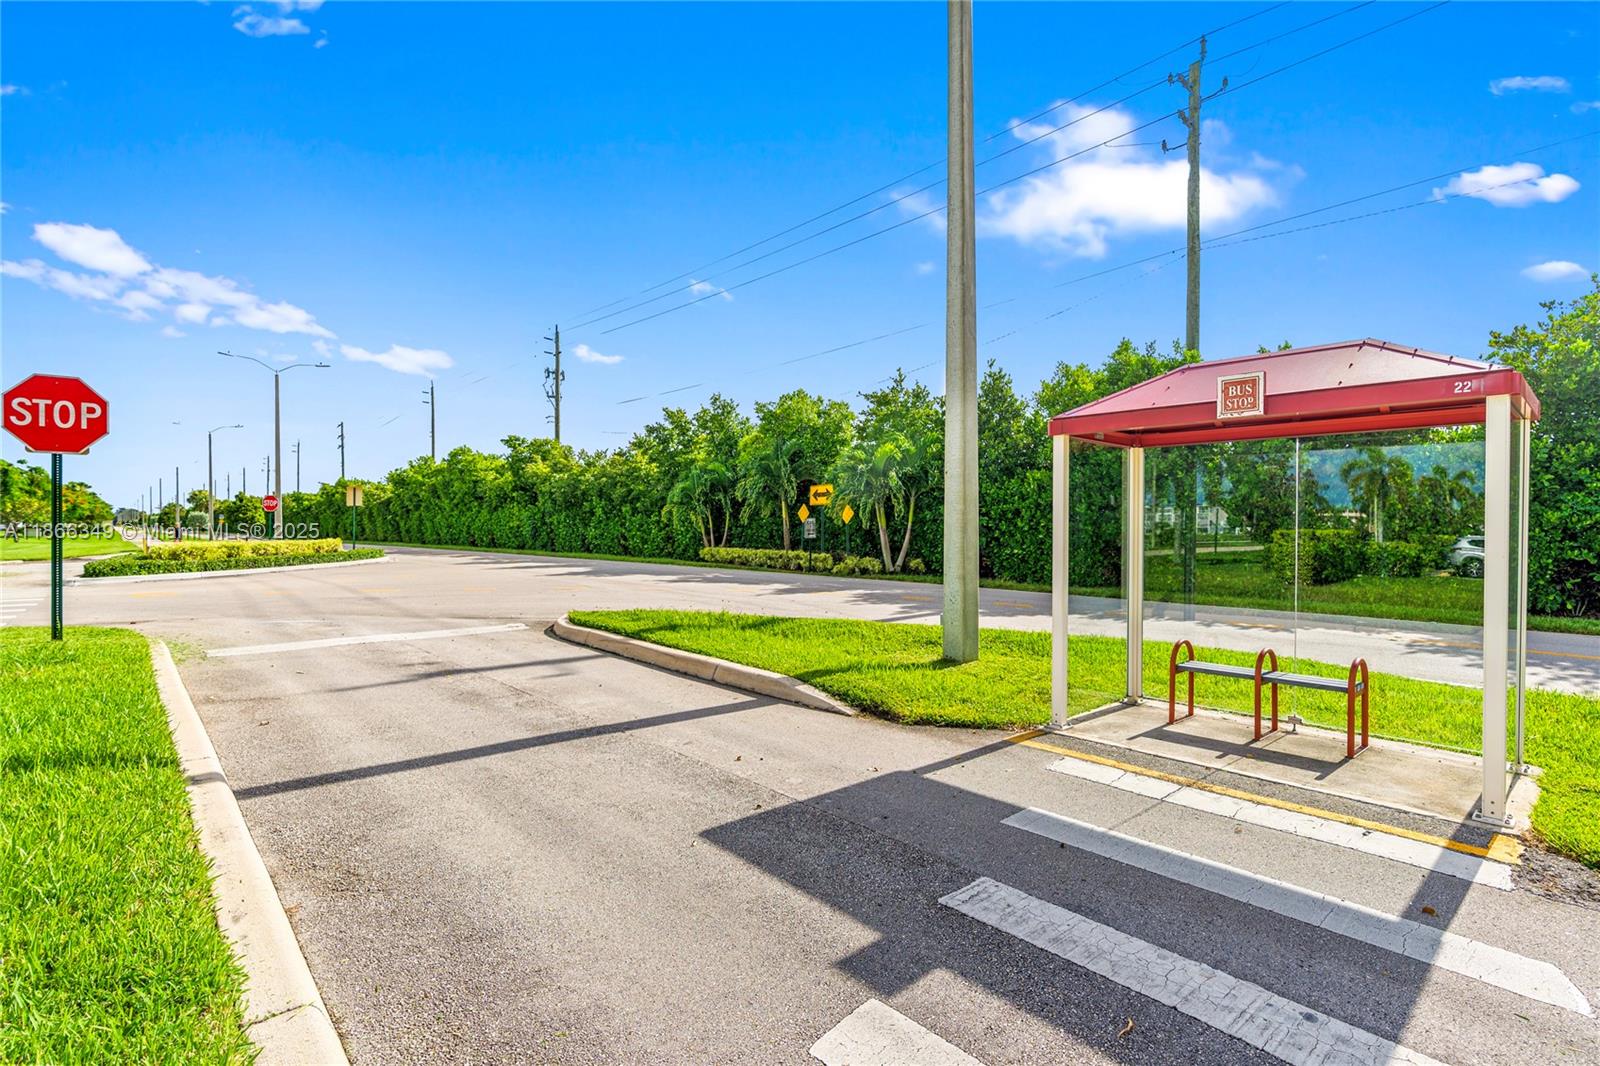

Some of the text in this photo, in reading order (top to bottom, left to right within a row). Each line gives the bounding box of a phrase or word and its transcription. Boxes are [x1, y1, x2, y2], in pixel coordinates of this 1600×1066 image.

[1228, 383, 1253, 397] BUS
[1454, 380, 1472, 393] 22
[1226, 396, 1254, 410] STOP
[9, 397, 102, 430] STOP
[263, 499, 278, 507] STOP
